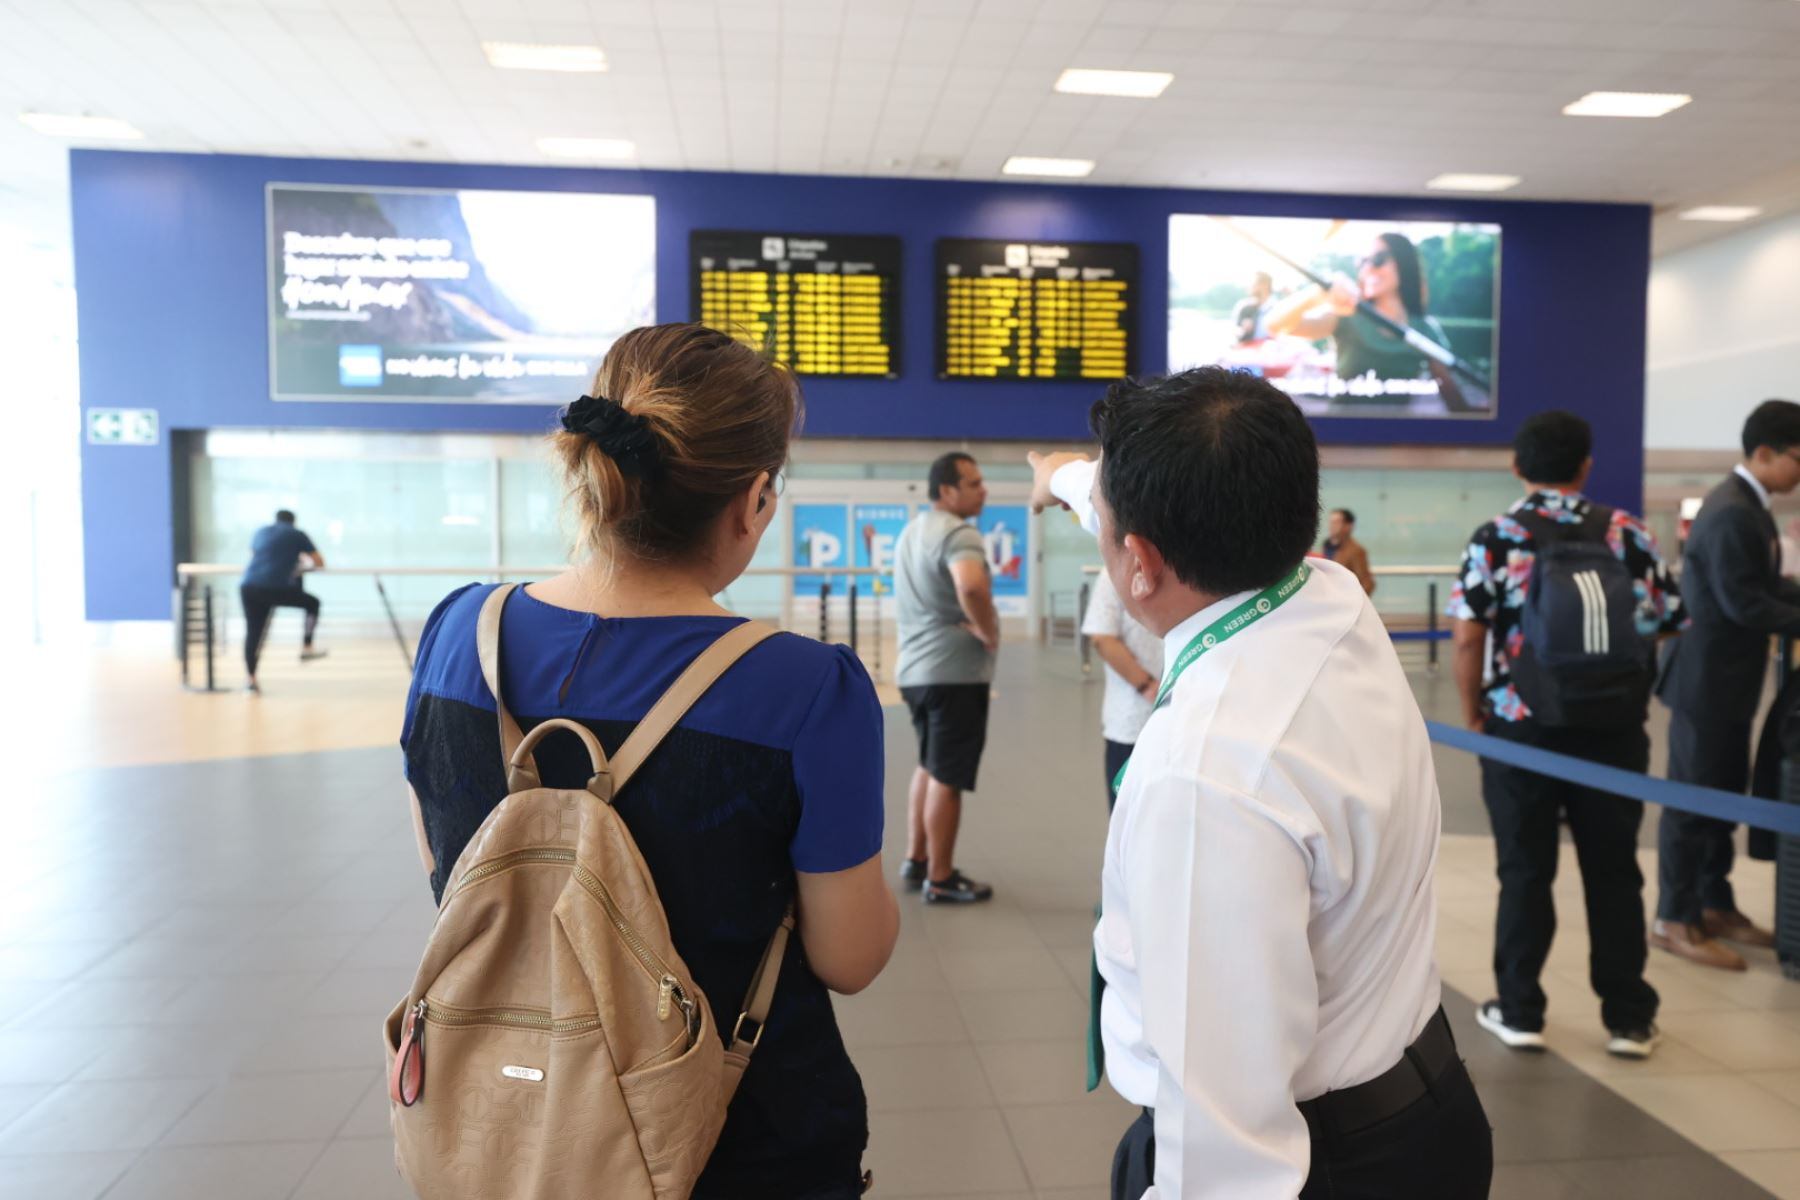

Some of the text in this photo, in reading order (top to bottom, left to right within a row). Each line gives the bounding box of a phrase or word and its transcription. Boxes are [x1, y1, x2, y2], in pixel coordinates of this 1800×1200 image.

[1278, 575, 1301, 598] GREEN
[1224, 608, 1258, 633] GREEN
[1178, 644, 1203, 667] GREEN
